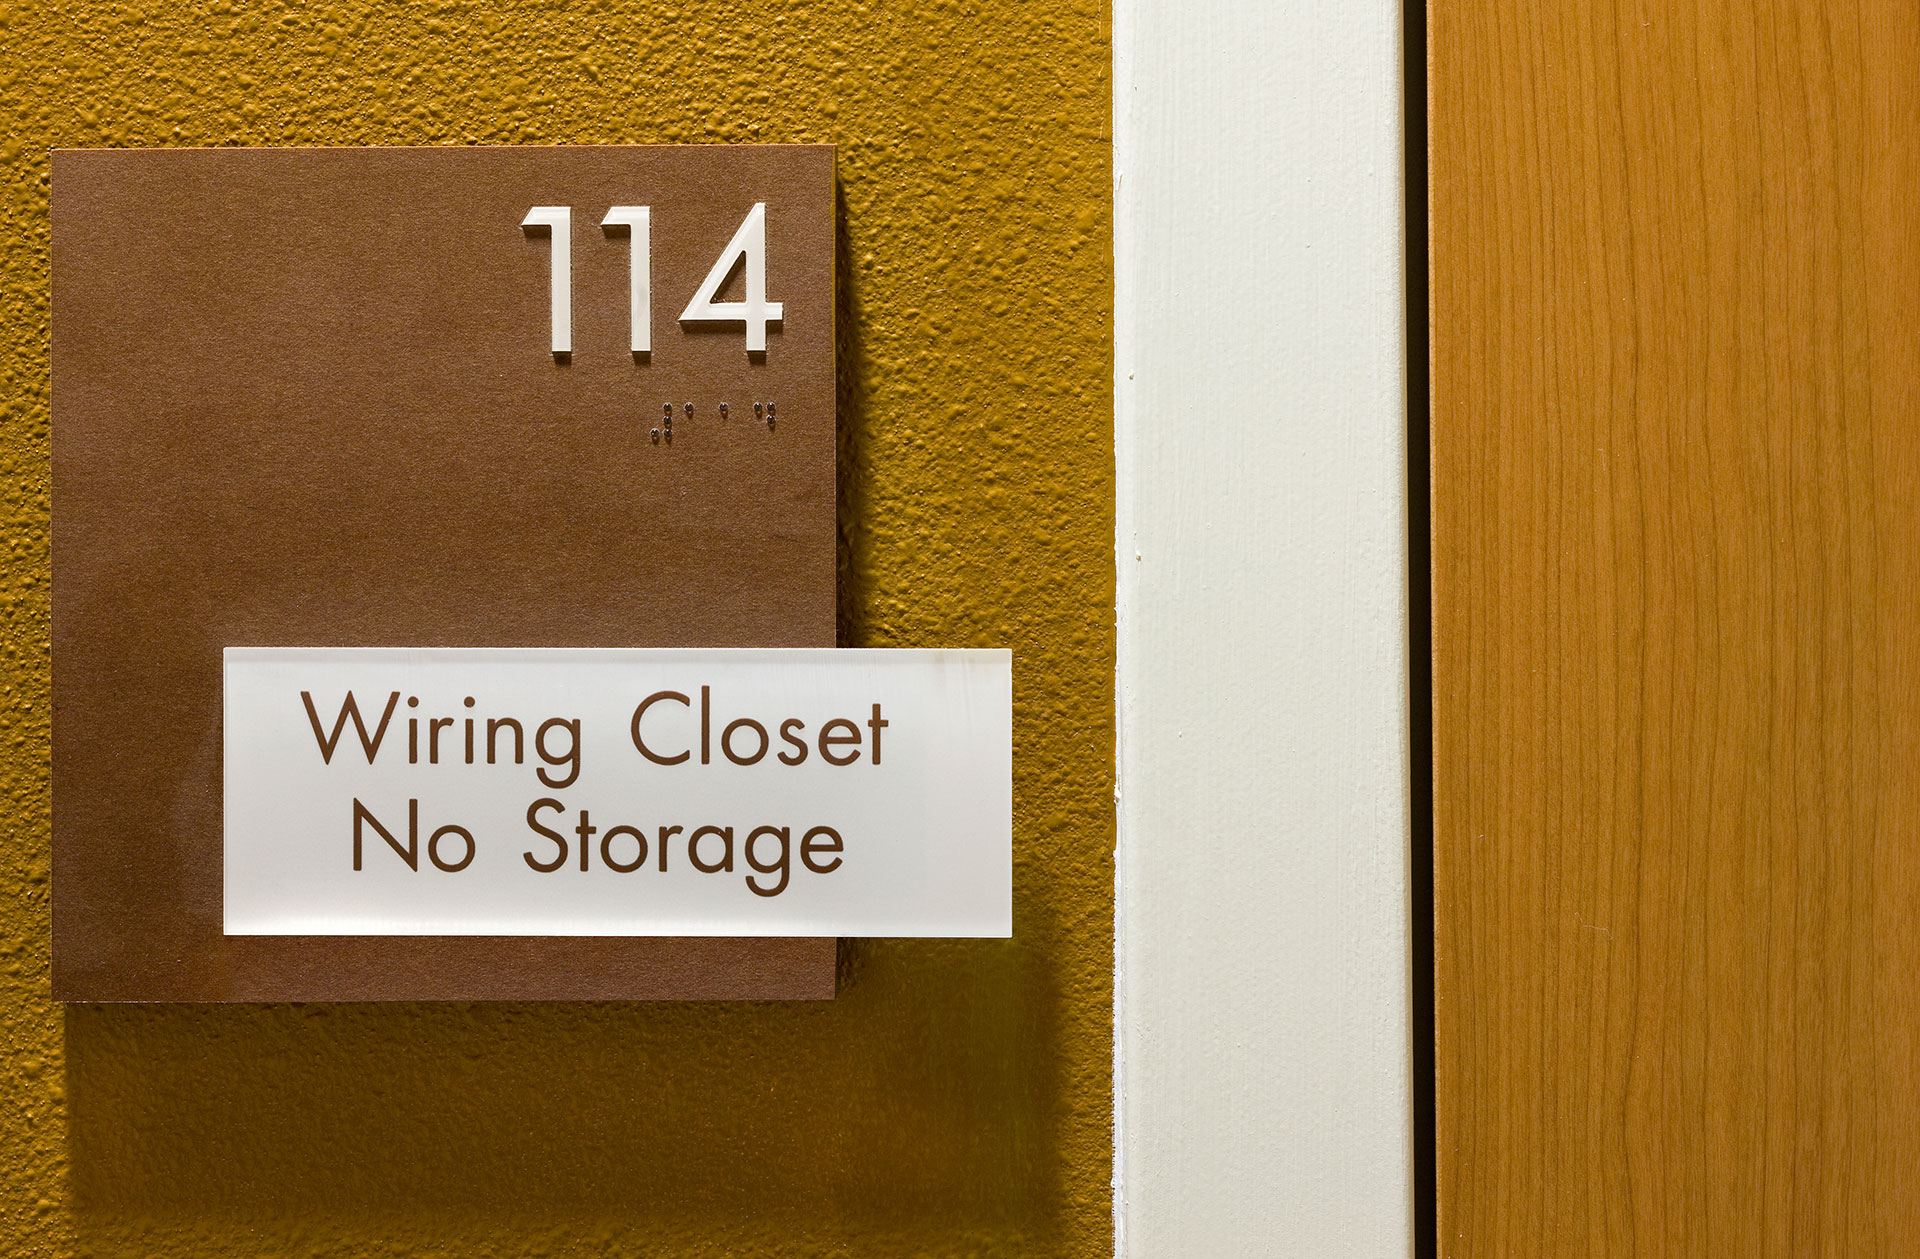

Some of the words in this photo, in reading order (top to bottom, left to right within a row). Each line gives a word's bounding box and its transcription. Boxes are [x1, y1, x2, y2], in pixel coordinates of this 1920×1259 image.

[521, 202, 783, 352] 114
[300, 690, 581, 790] Wiring
[630, 685, 889, 766] Closet
[352, 797, 476, 873] No
[522, 797, 845, 898] Storage
